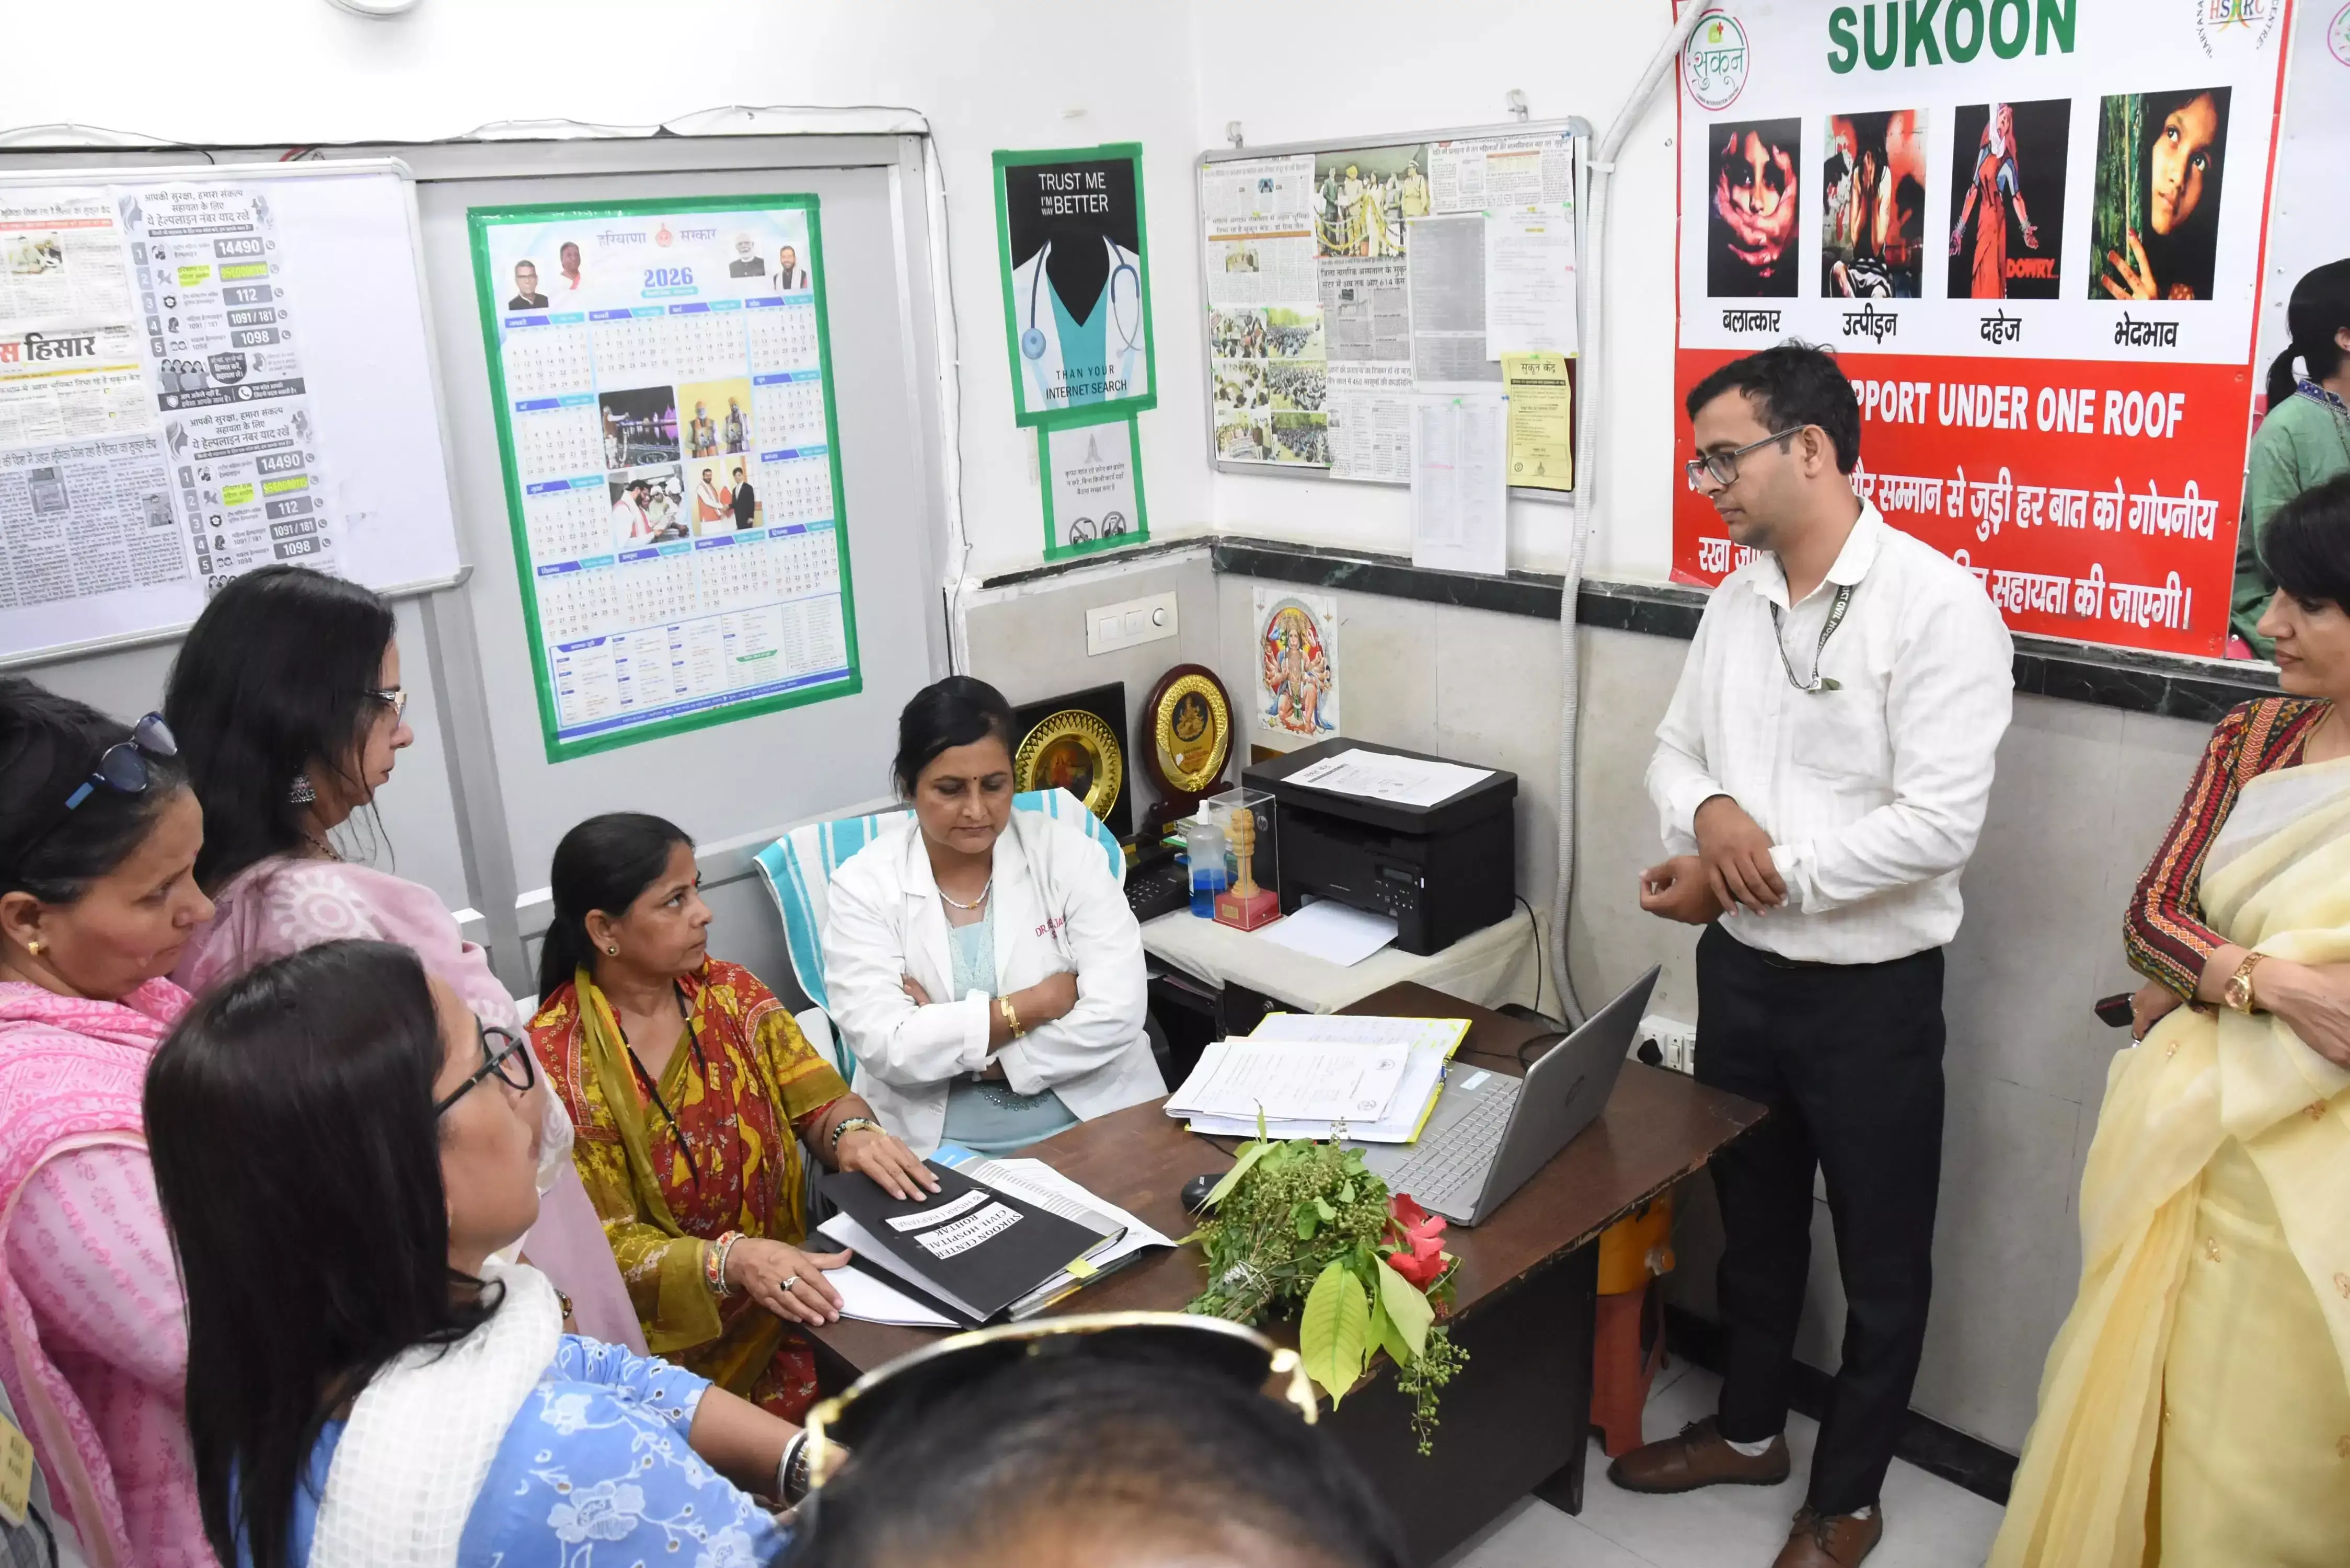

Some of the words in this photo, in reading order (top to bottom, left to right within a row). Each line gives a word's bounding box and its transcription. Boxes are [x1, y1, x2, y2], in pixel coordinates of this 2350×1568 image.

[1827, 0, 2076, 74] SUKOON
[1038, 172, 1081, 191] TRUST
[1086, 172, 1106, 189] ME
[145, 191, 168, 202] आपकी
[171, 203, 199, 212] सहायता
[1041, 196, 1052, 206] I'M
[1054, 194, 1109, 214] BETTER
[220, 239, 260, 256] 14490
[596, 229, 646, 247] हरियाणा
[679, 227, 717, 241] सरकार
[643, 266, 694, 287] 2026
[236, 289, 258, 303] 112
[150, 321, 158, 331] 4
[231, 312, 252, 325] 1091
[259, 310, 274, 322] 181
[1723, 310, 1781, 332] बलात्कार
[1842, 303, 1898, 344] उत्पीड़न
[1980, 308, 2022, 344] दहेज
[2115, 310, 2179, 347] भेदभाव
[24, 332, 96, 361] हिसार
[155, 342, 163, 353] 5
[240, 330, 270, 345] 1098
[1056, 368, 1084, 381] THAN
[1088, 365, 1115, 376] YOUR
[1520, 363, 1541, 375] सुकून
[1046, 384, 1089, 400] INTERNET
[1092, 379, 1127, 395] SEARCH
[1853, 380, 1931, 424] PPORT
[1938, 383, 2029, 430] UNDER
[2037, 387, 2095, 434] ONE
[2103, 390, 2185, 438] ROOF
[190, 414, 213, 427] आपकी
[215, 423, 241, 434] सहायता
[183, 473, 189, 483] 1
[261, 454, 301, 471] 14490
[188, 496, 195, 506] 2
[1879, 474, 1942, 515] सम्मान
[1947, 465, 1967, 518] से
[1970, 466, 2012, 543] जुड़ी
[2017, 485, 2046, 528] हर
[2049, 487, 2089, 529] बात
[2093, 477, 2125, 532] को
[2128, 479, 2219, 540] गोपनीय
[193, 518, 200, 528] 3
[278, 501, 298, 515] 112
[198, 540, 205, 550] 4
[273, 523, 294, 537] 1091
[299, 520, 315, 532] 181
[202, 560, 209, 570] 5
[283, 539, 311, 555] 1098
[1699, 537, 1732, 573] रखा
[1992, 569, 2071, 614] सहायता
[2075, 563, 2105, 619] की
[1833, 601, 1846, 619] CIVIL
[947, 1200, 973, 1214] HISAR
[934, 1214, 978, 1236] ROHTAK
[977, 1212, 1021, 1241] SUKOON
[926, 1226, 979, 1249] HOSPITAL
[935, 1237, 977, 1259] CENTER
